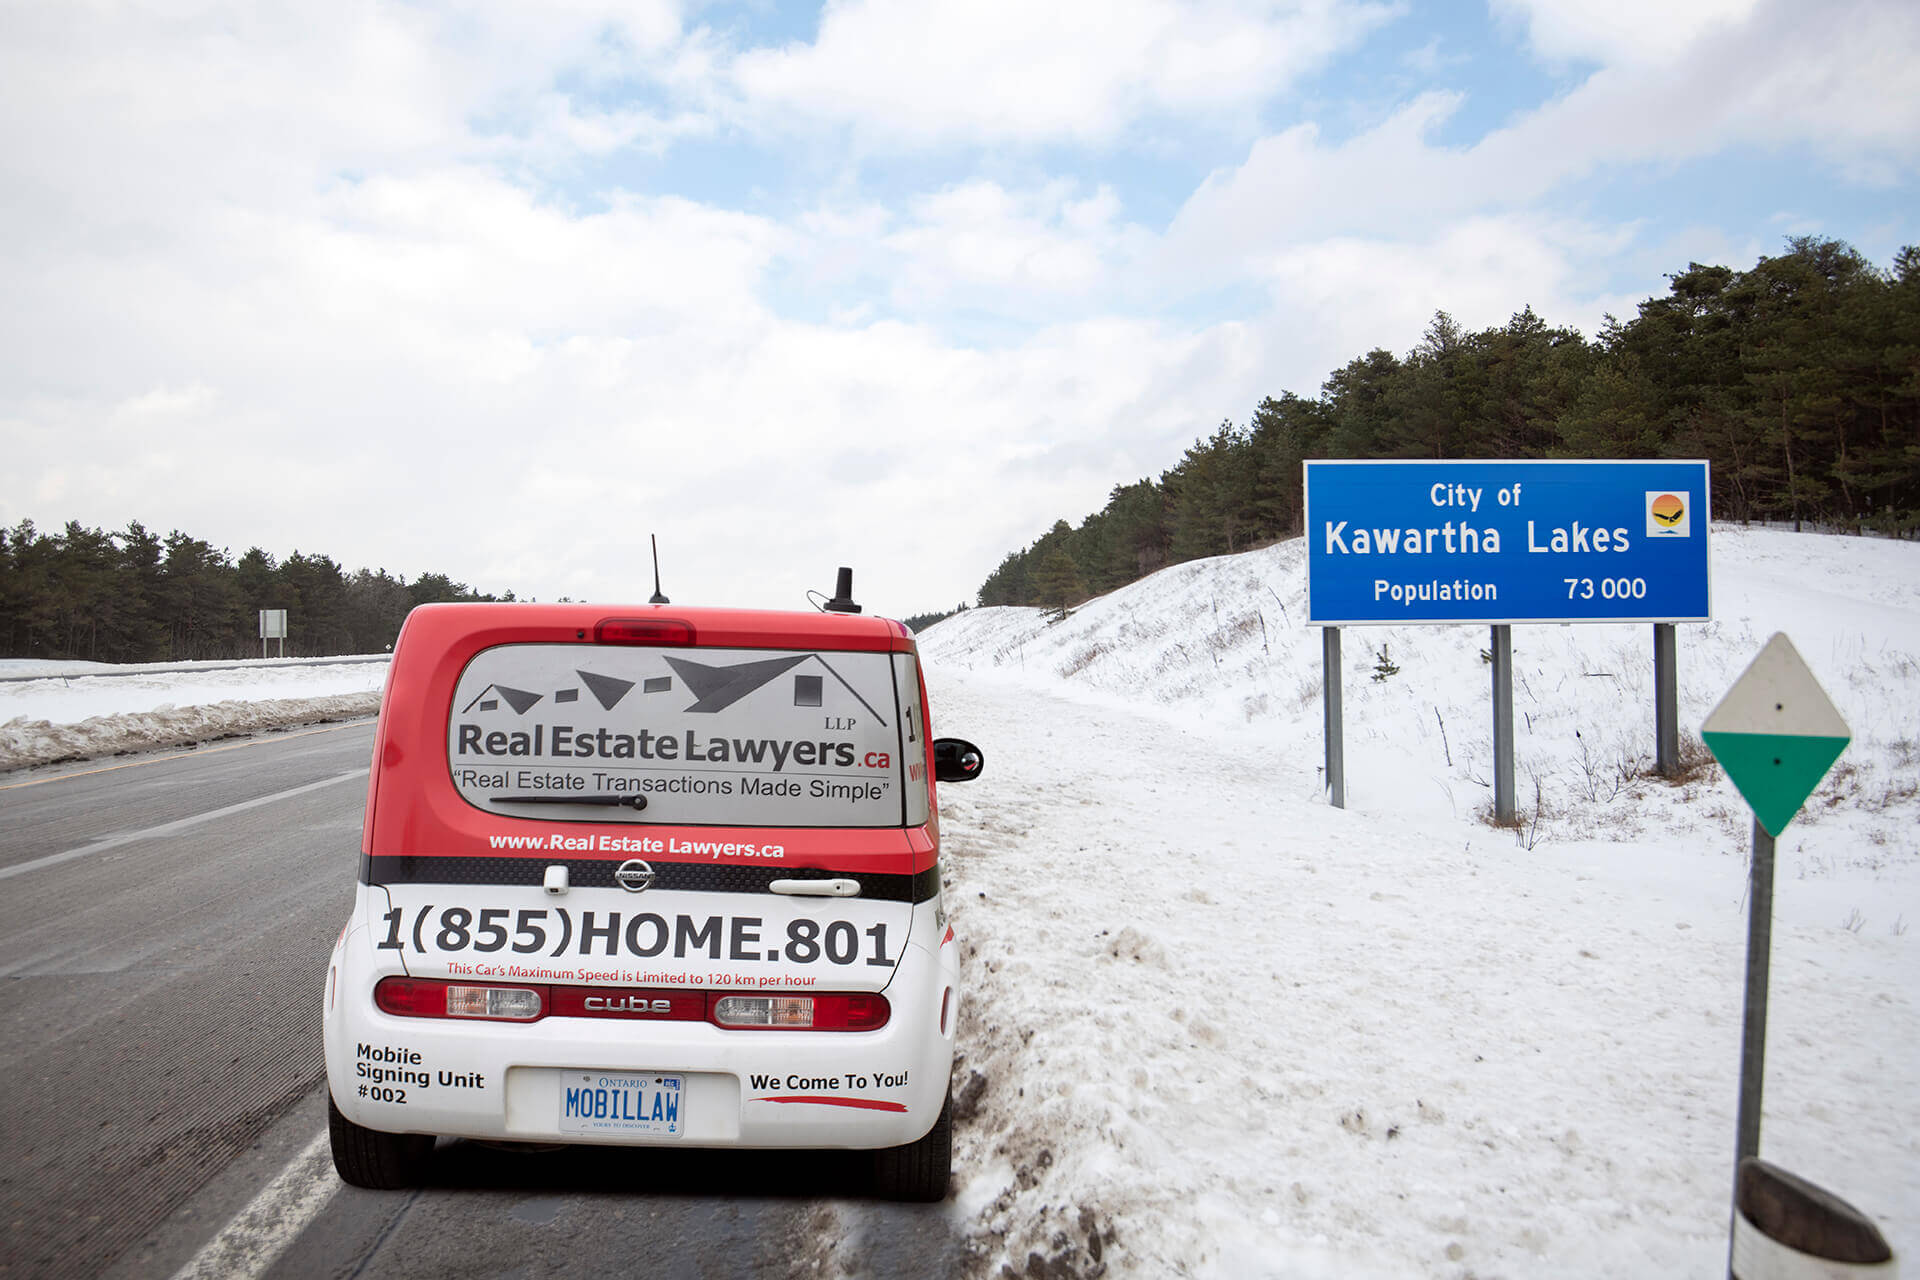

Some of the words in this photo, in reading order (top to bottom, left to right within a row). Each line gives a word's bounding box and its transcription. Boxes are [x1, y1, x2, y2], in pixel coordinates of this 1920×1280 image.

[1430, 482, 1483, 512] City
[1497, 483, 1521, 506] of
[1325, 521, 1500, 554] Kawartha
[1527, 520, 1630, 553] Lakes
[1374, 579, 1497, 606] Population
[824, 717, 857, 730] LLP
[518, 771, 585, 790] Estate
[592, 773, 733, 795] Transactions
[741, 777, 801, 797] Made
[599, 836, 664, 853] Estate
[377, 905, 895, 967] 1(855)HOME.801
[447, 963, 472, 975] This
[508, 965, 574, 980] Maximum
[577, 970, 618, 983] Speed
[622, 971, 633, 982] is
[636, 971, 686, 984] Limited
[690, 975, 704, 984] to
[708, 973, 732, 985] 120
[735, 974, 756, 985] km
[759, 977, 782, 989] per
[785, 974, 817, 987] hour
[584, 996, 671, 1014] cube
[356, 1062, 430, 1088] Signing
[438, 1070, 485, 1089] Unit
[750, 1074, 781, 1090] We
[786, 1074, 840, 1090] Come
[844, 1074, 867, 1089] To
[873, 1070, 909, 1088] You!
[358, 1084, 407, 1104] #002
[565, 1087, 679, 1122] MOBILLAW
